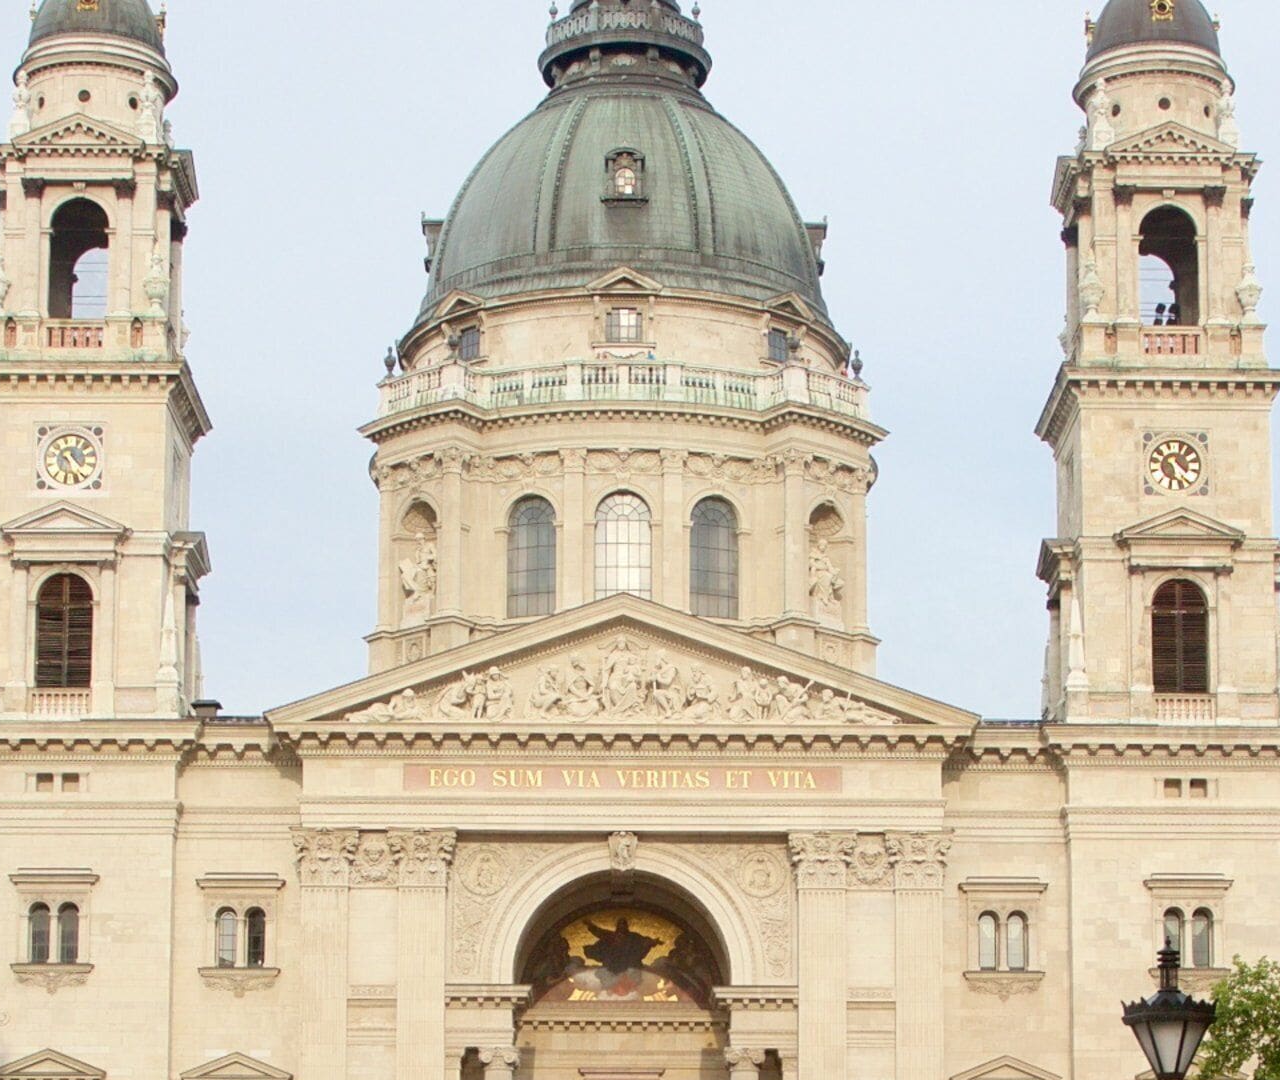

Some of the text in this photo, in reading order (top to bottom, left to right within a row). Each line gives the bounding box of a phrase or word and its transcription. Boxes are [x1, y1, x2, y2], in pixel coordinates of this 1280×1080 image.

[429, 768, 816, 789] EGO SUM VIA VERITAS ET VITA
